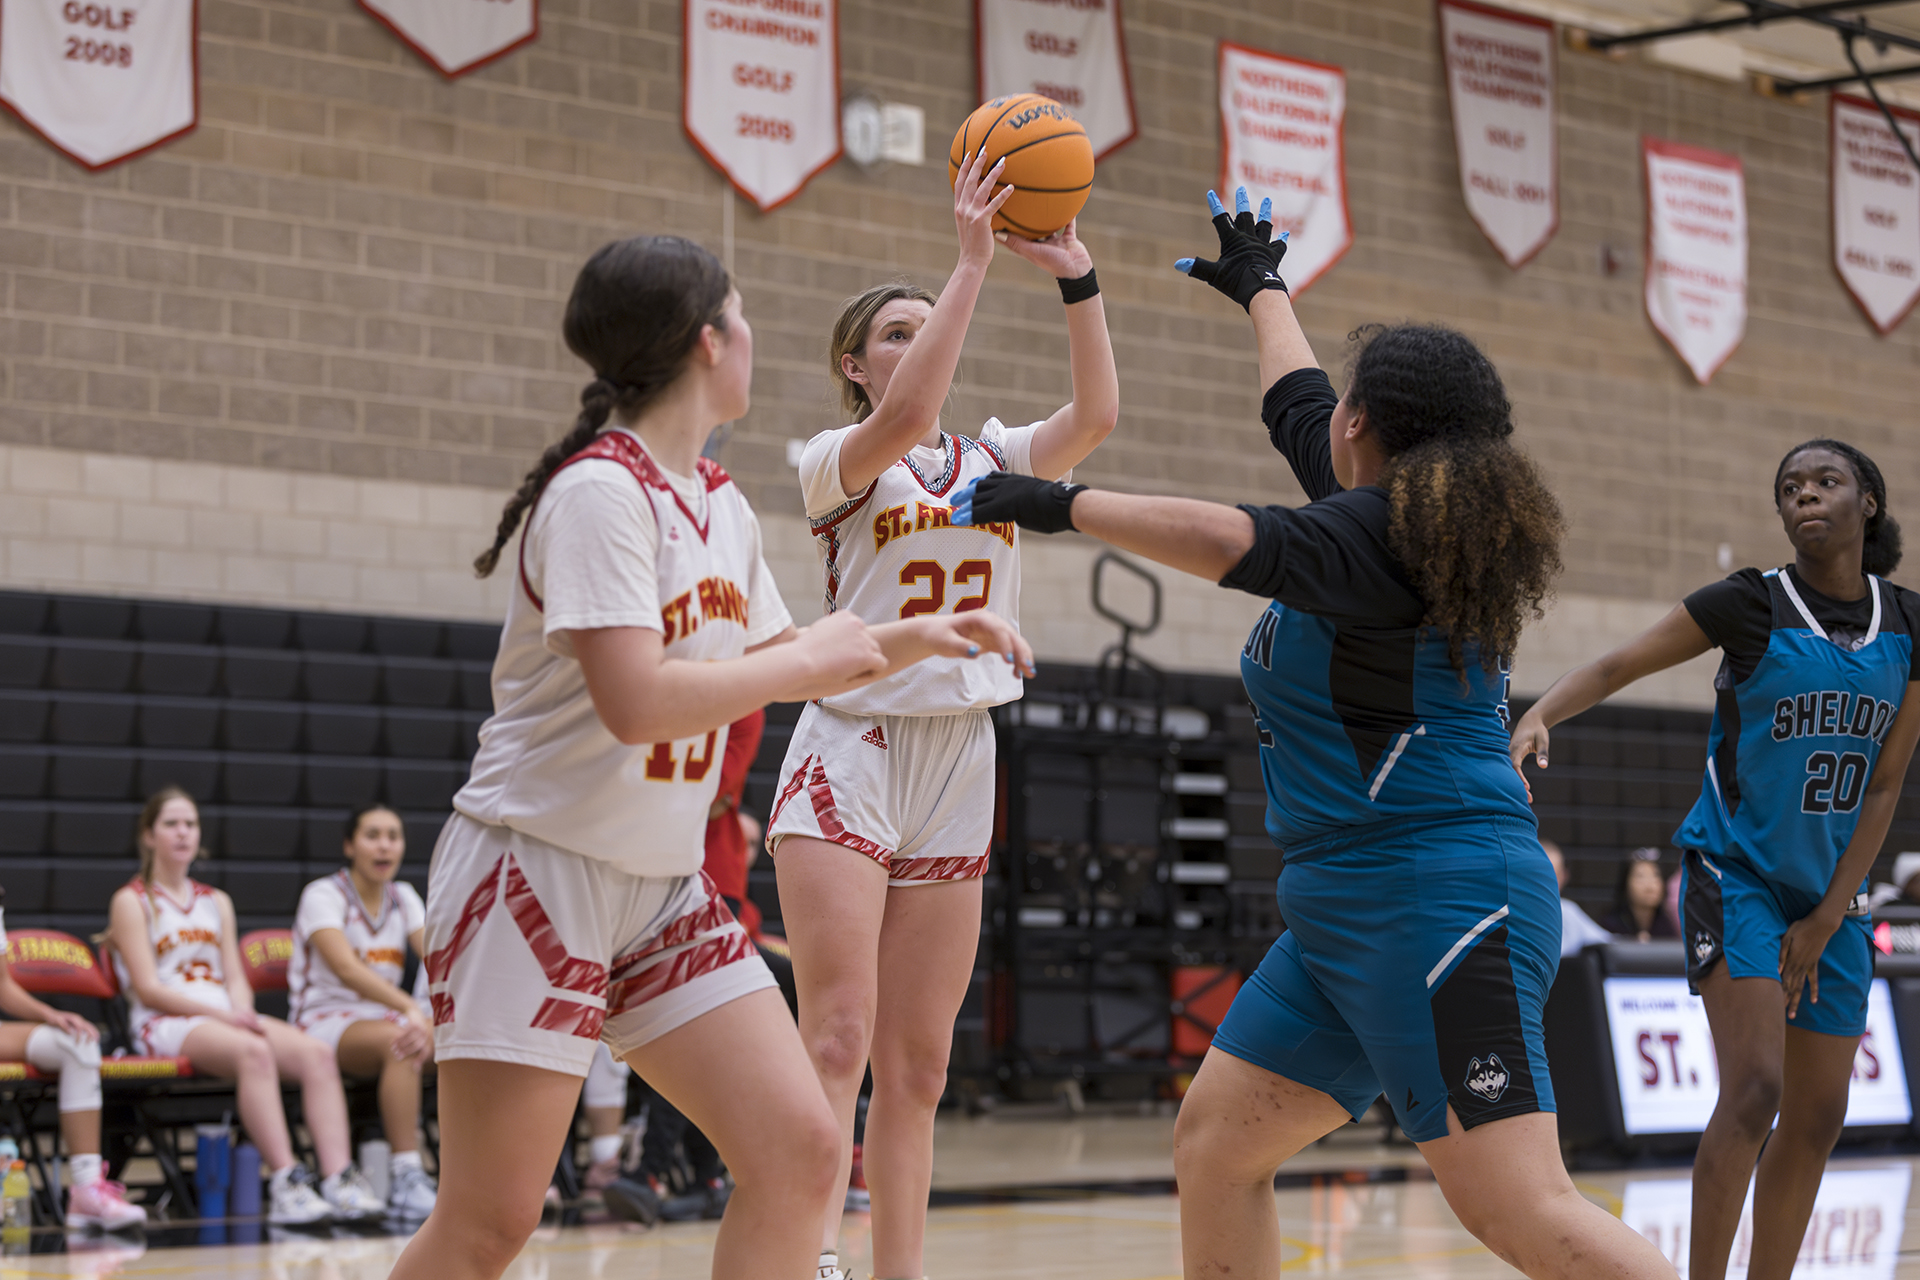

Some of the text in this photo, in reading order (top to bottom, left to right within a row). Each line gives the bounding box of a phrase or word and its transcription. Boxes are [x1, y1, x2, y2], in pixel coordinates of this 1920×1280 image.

[63, 1, 136, 32] GOLF
[65, 36, 133, 68] 2008
[733, 62, 796, 94] GOLF
[873, 503, 913, 554] ST.
[899, 559, 992, 619] 22
[661, 590, 697, 648] ST.
[861, 734, 888, 751] adidas
[1801, 751, 1869, 815] 20
[1637, 1030, 1699, 1089] ST.
